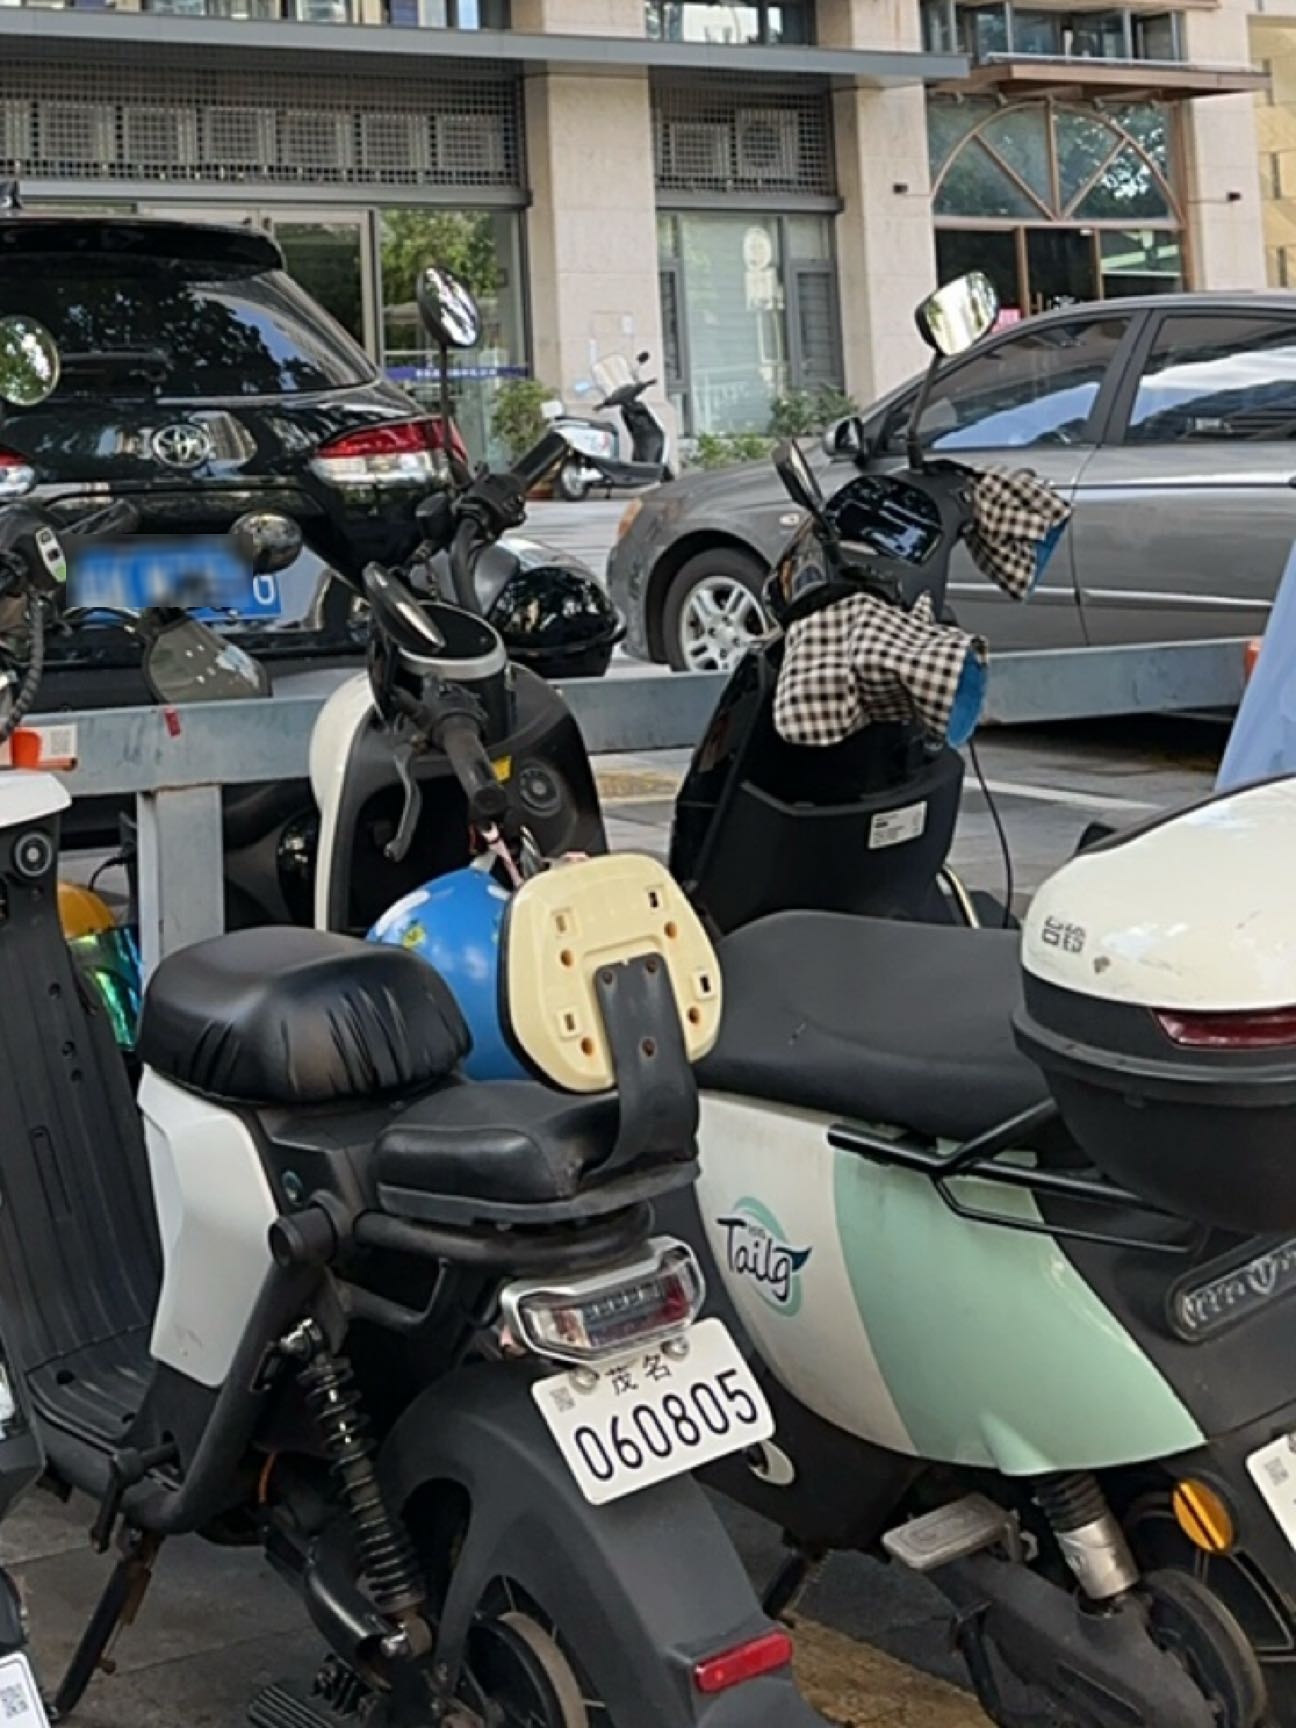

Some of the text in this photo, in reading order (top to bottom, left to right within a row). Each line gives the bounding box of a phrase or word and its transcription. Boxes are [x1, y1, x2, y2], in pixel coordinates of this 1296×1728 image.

[714, 1216, 813, 1304] Tailg
[605, 1353, 672, 1397] 茂名
[573, 1367, 759, 1482] 060805
